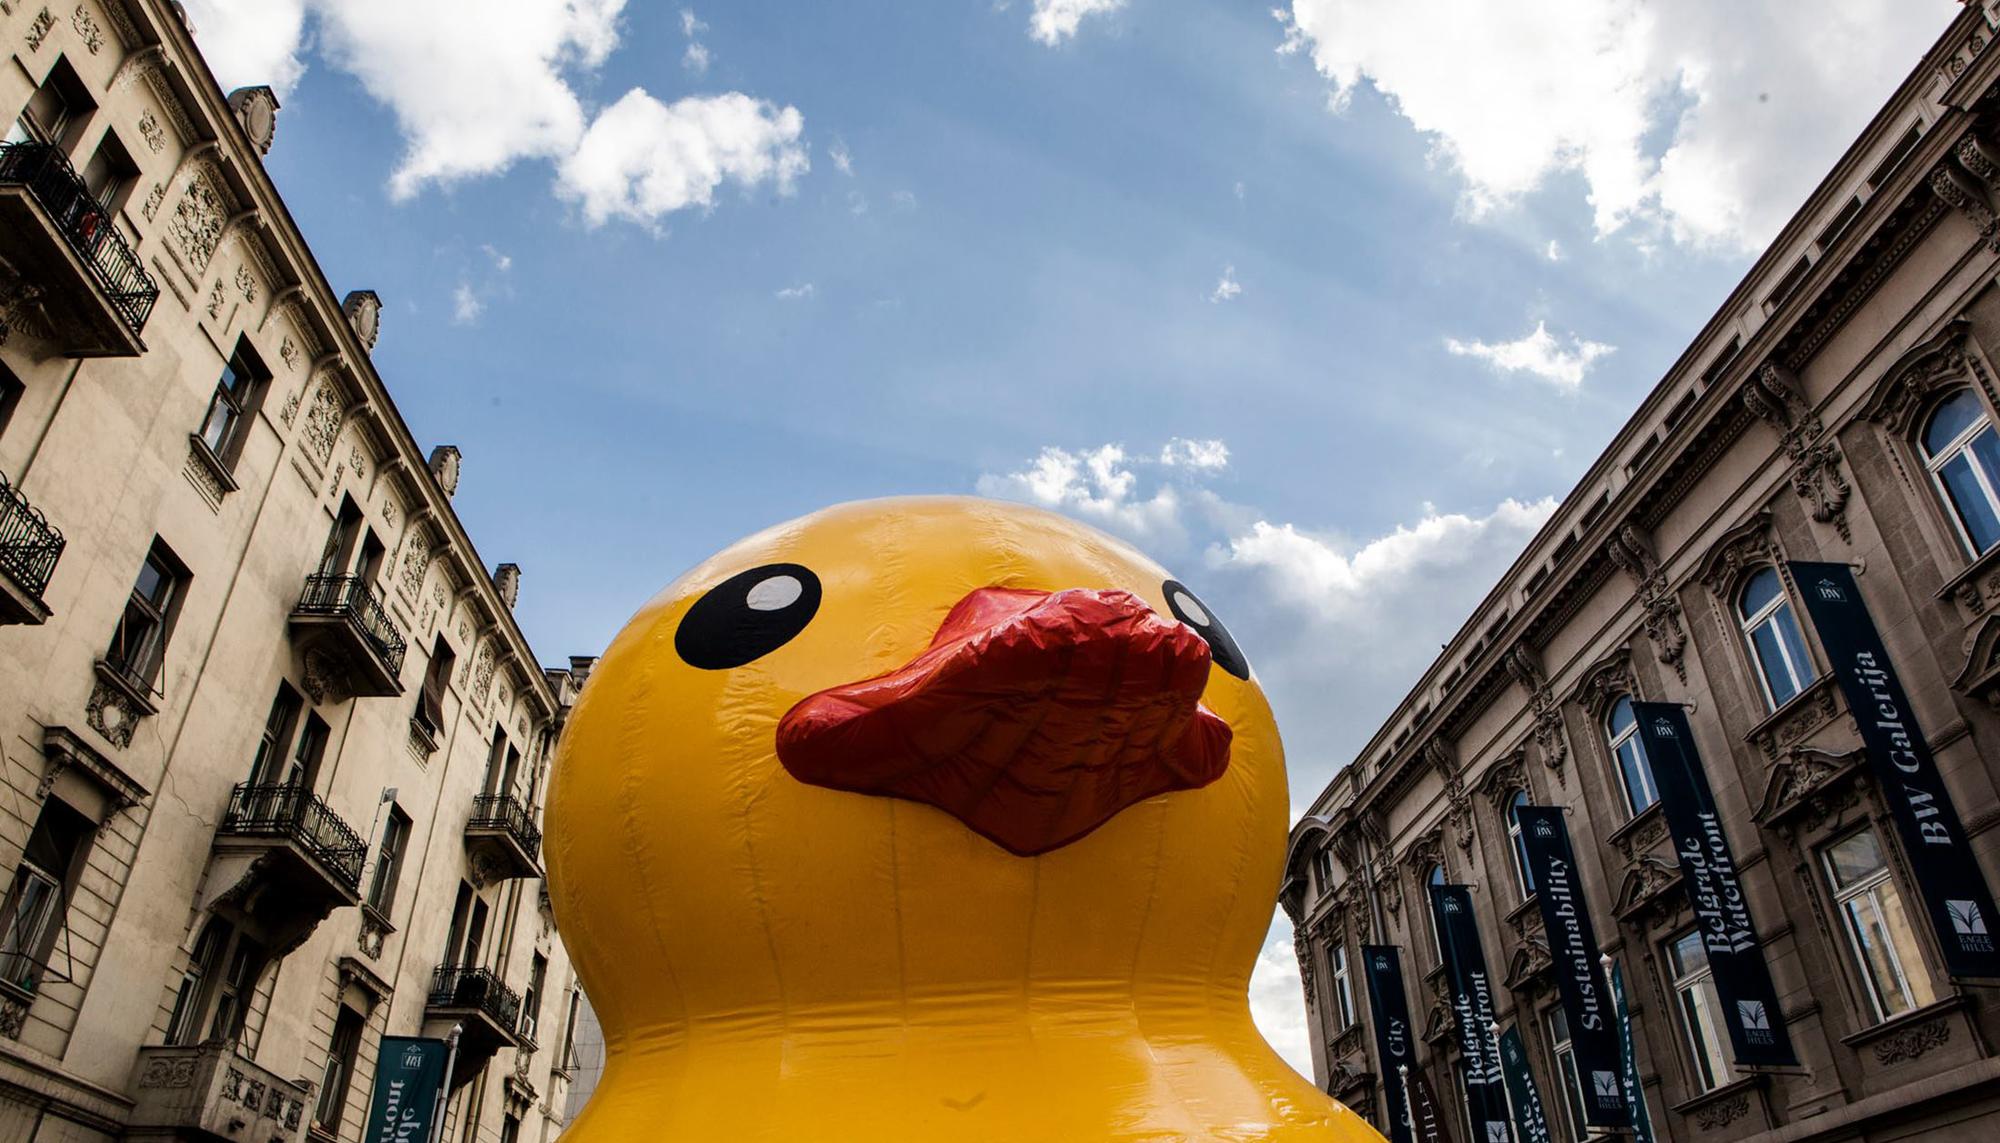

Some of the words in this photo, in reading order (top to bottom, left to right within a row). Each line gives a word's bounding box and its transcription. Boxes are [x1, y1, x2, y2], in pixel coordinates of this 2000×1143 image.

[1854, 650, 1920, 774] Galerija
[1904, 786, 1953, 847] BW
[1681, 837, 1734, 954] Belgrade
[1697, 811, 1756, 955] Waterfront
[1549, 855, 1603, 1032] Sustainability
[1961, 943, 1995, 952] HILLS
[1388, 1016, 1406, 1057] City
[1455, 993, 1487, 1086] Belgrade
